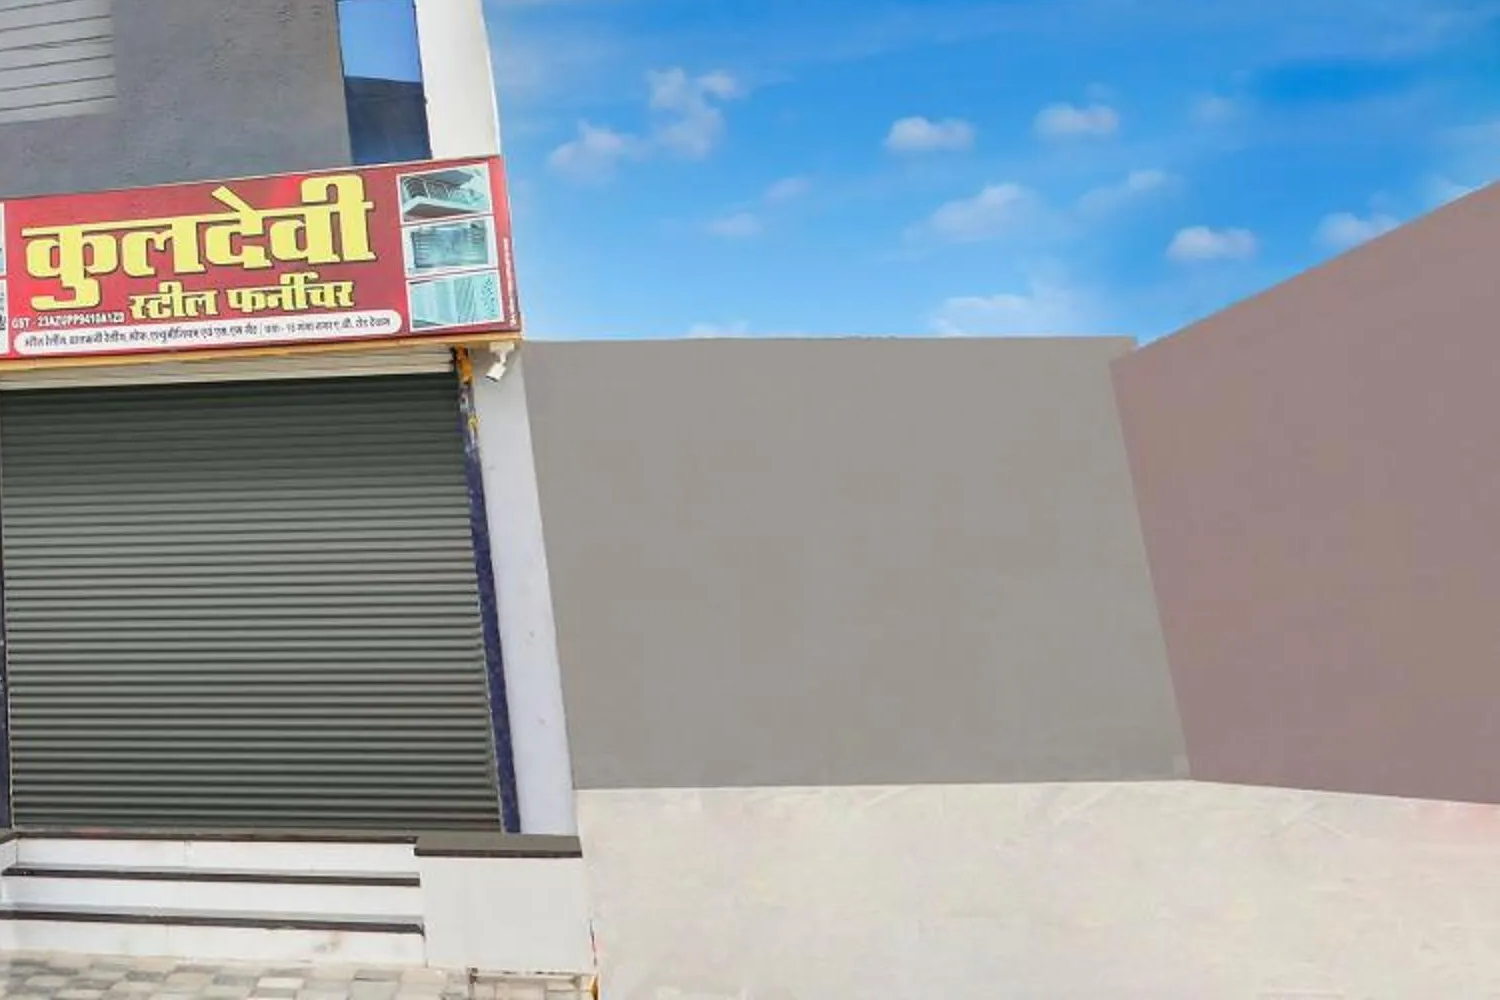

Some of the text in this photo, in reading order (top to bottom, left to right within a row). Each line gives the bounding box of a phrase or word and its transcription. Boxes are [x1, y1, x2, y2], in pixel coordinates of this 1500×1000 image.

[21, 174, 377, 311] कुलदेवी
[127, 272, 355, 320] स्टील फर्नीचर
